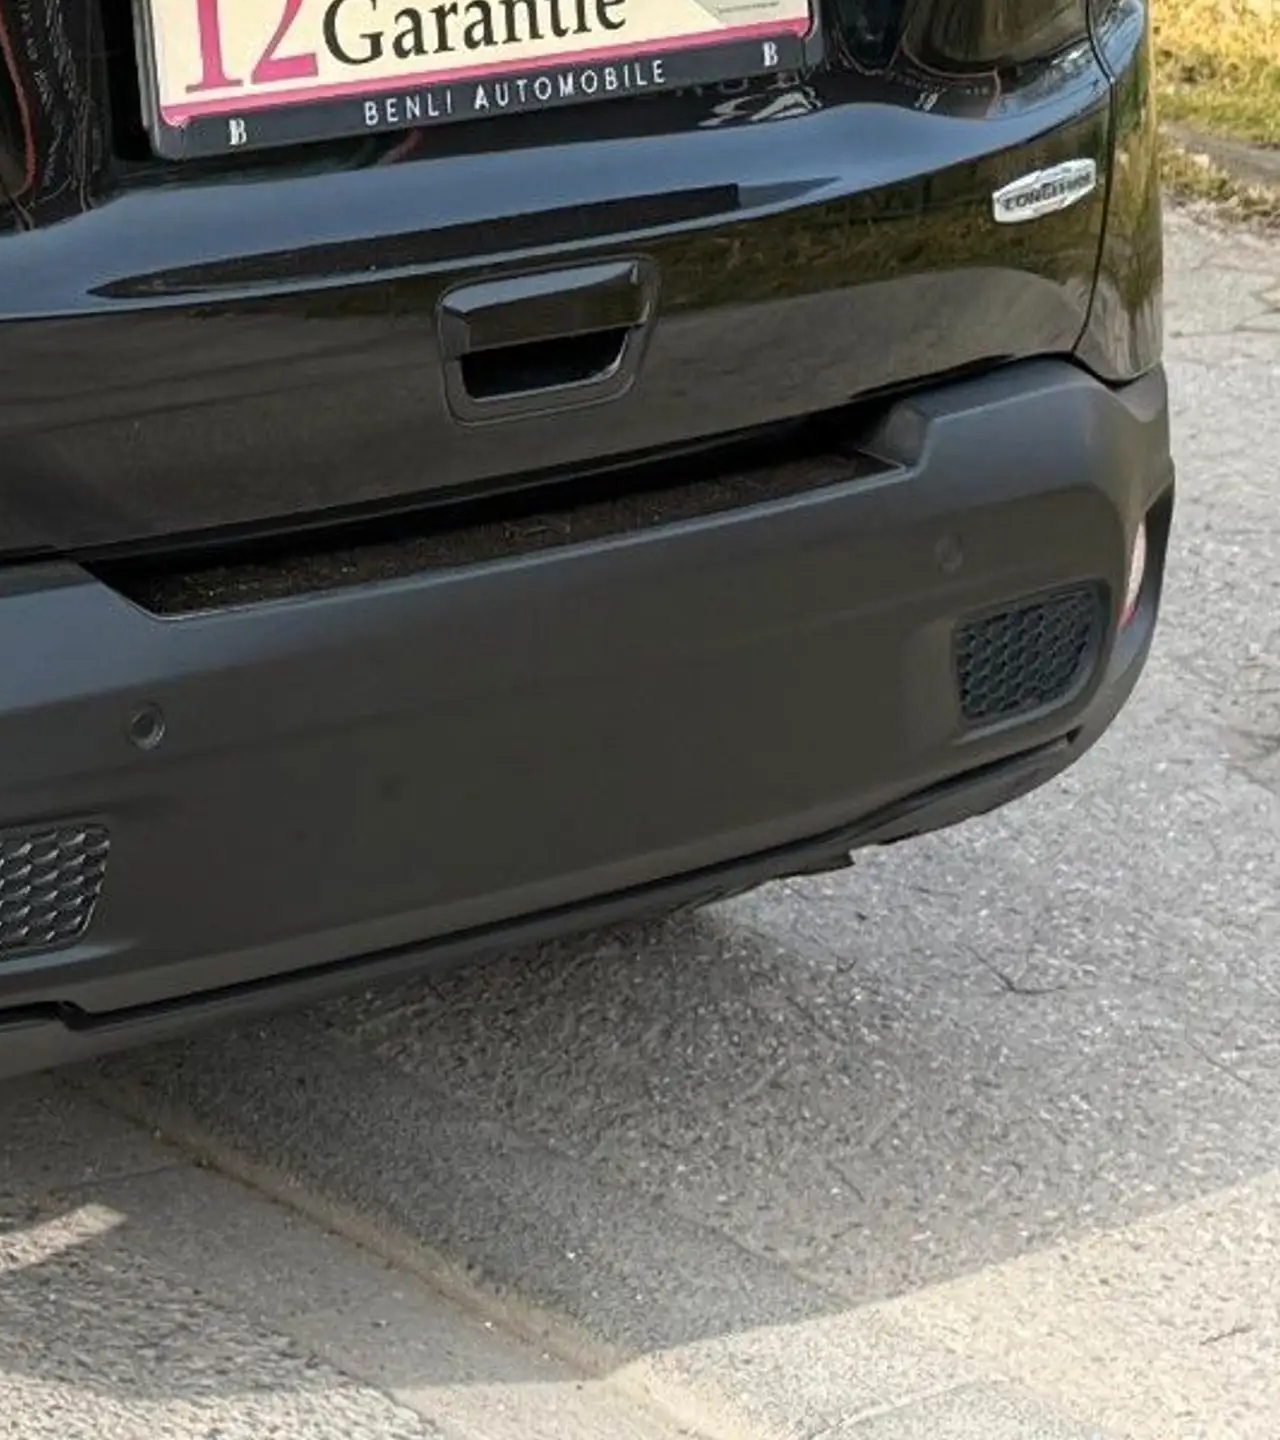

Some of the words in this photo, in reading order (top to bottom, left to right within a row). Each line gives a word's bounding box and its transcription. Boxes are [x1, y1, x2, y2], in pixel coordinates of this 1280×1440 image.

[762, 41, 780, 68] B
[364, 88, 454, 127] BENLI
[473, 59, 667, 111] AUTOMOBILE
[228, 117, 248, 147] B
